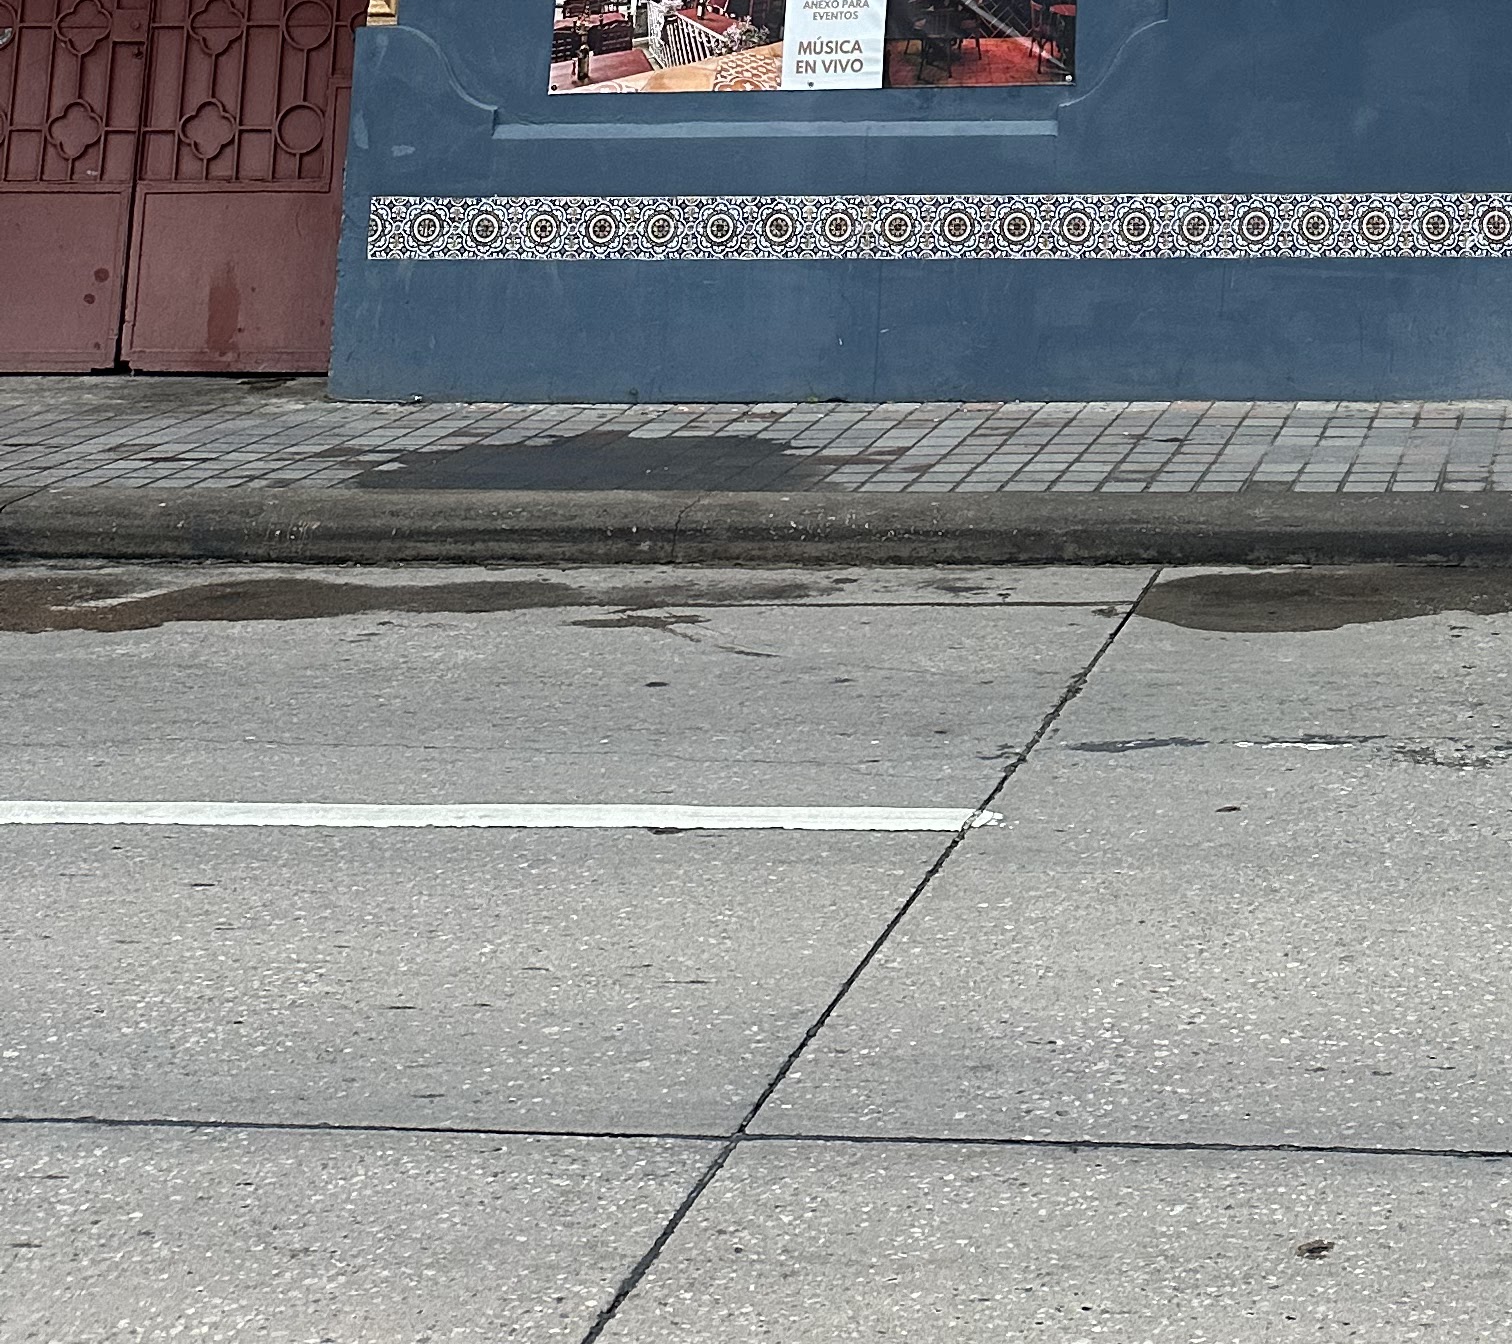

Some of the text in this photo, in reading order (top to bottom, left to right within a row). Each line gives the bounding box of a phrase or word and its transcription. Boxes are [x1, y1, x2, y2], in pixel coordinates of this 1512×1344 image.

[803, 0, 870, 10] ANEXO PARA
[812, 10, 859, 21] EVENTOS
[797, 36, 863, 56] MÚSICA
[795, 58, 864, 74] EN VIVO
